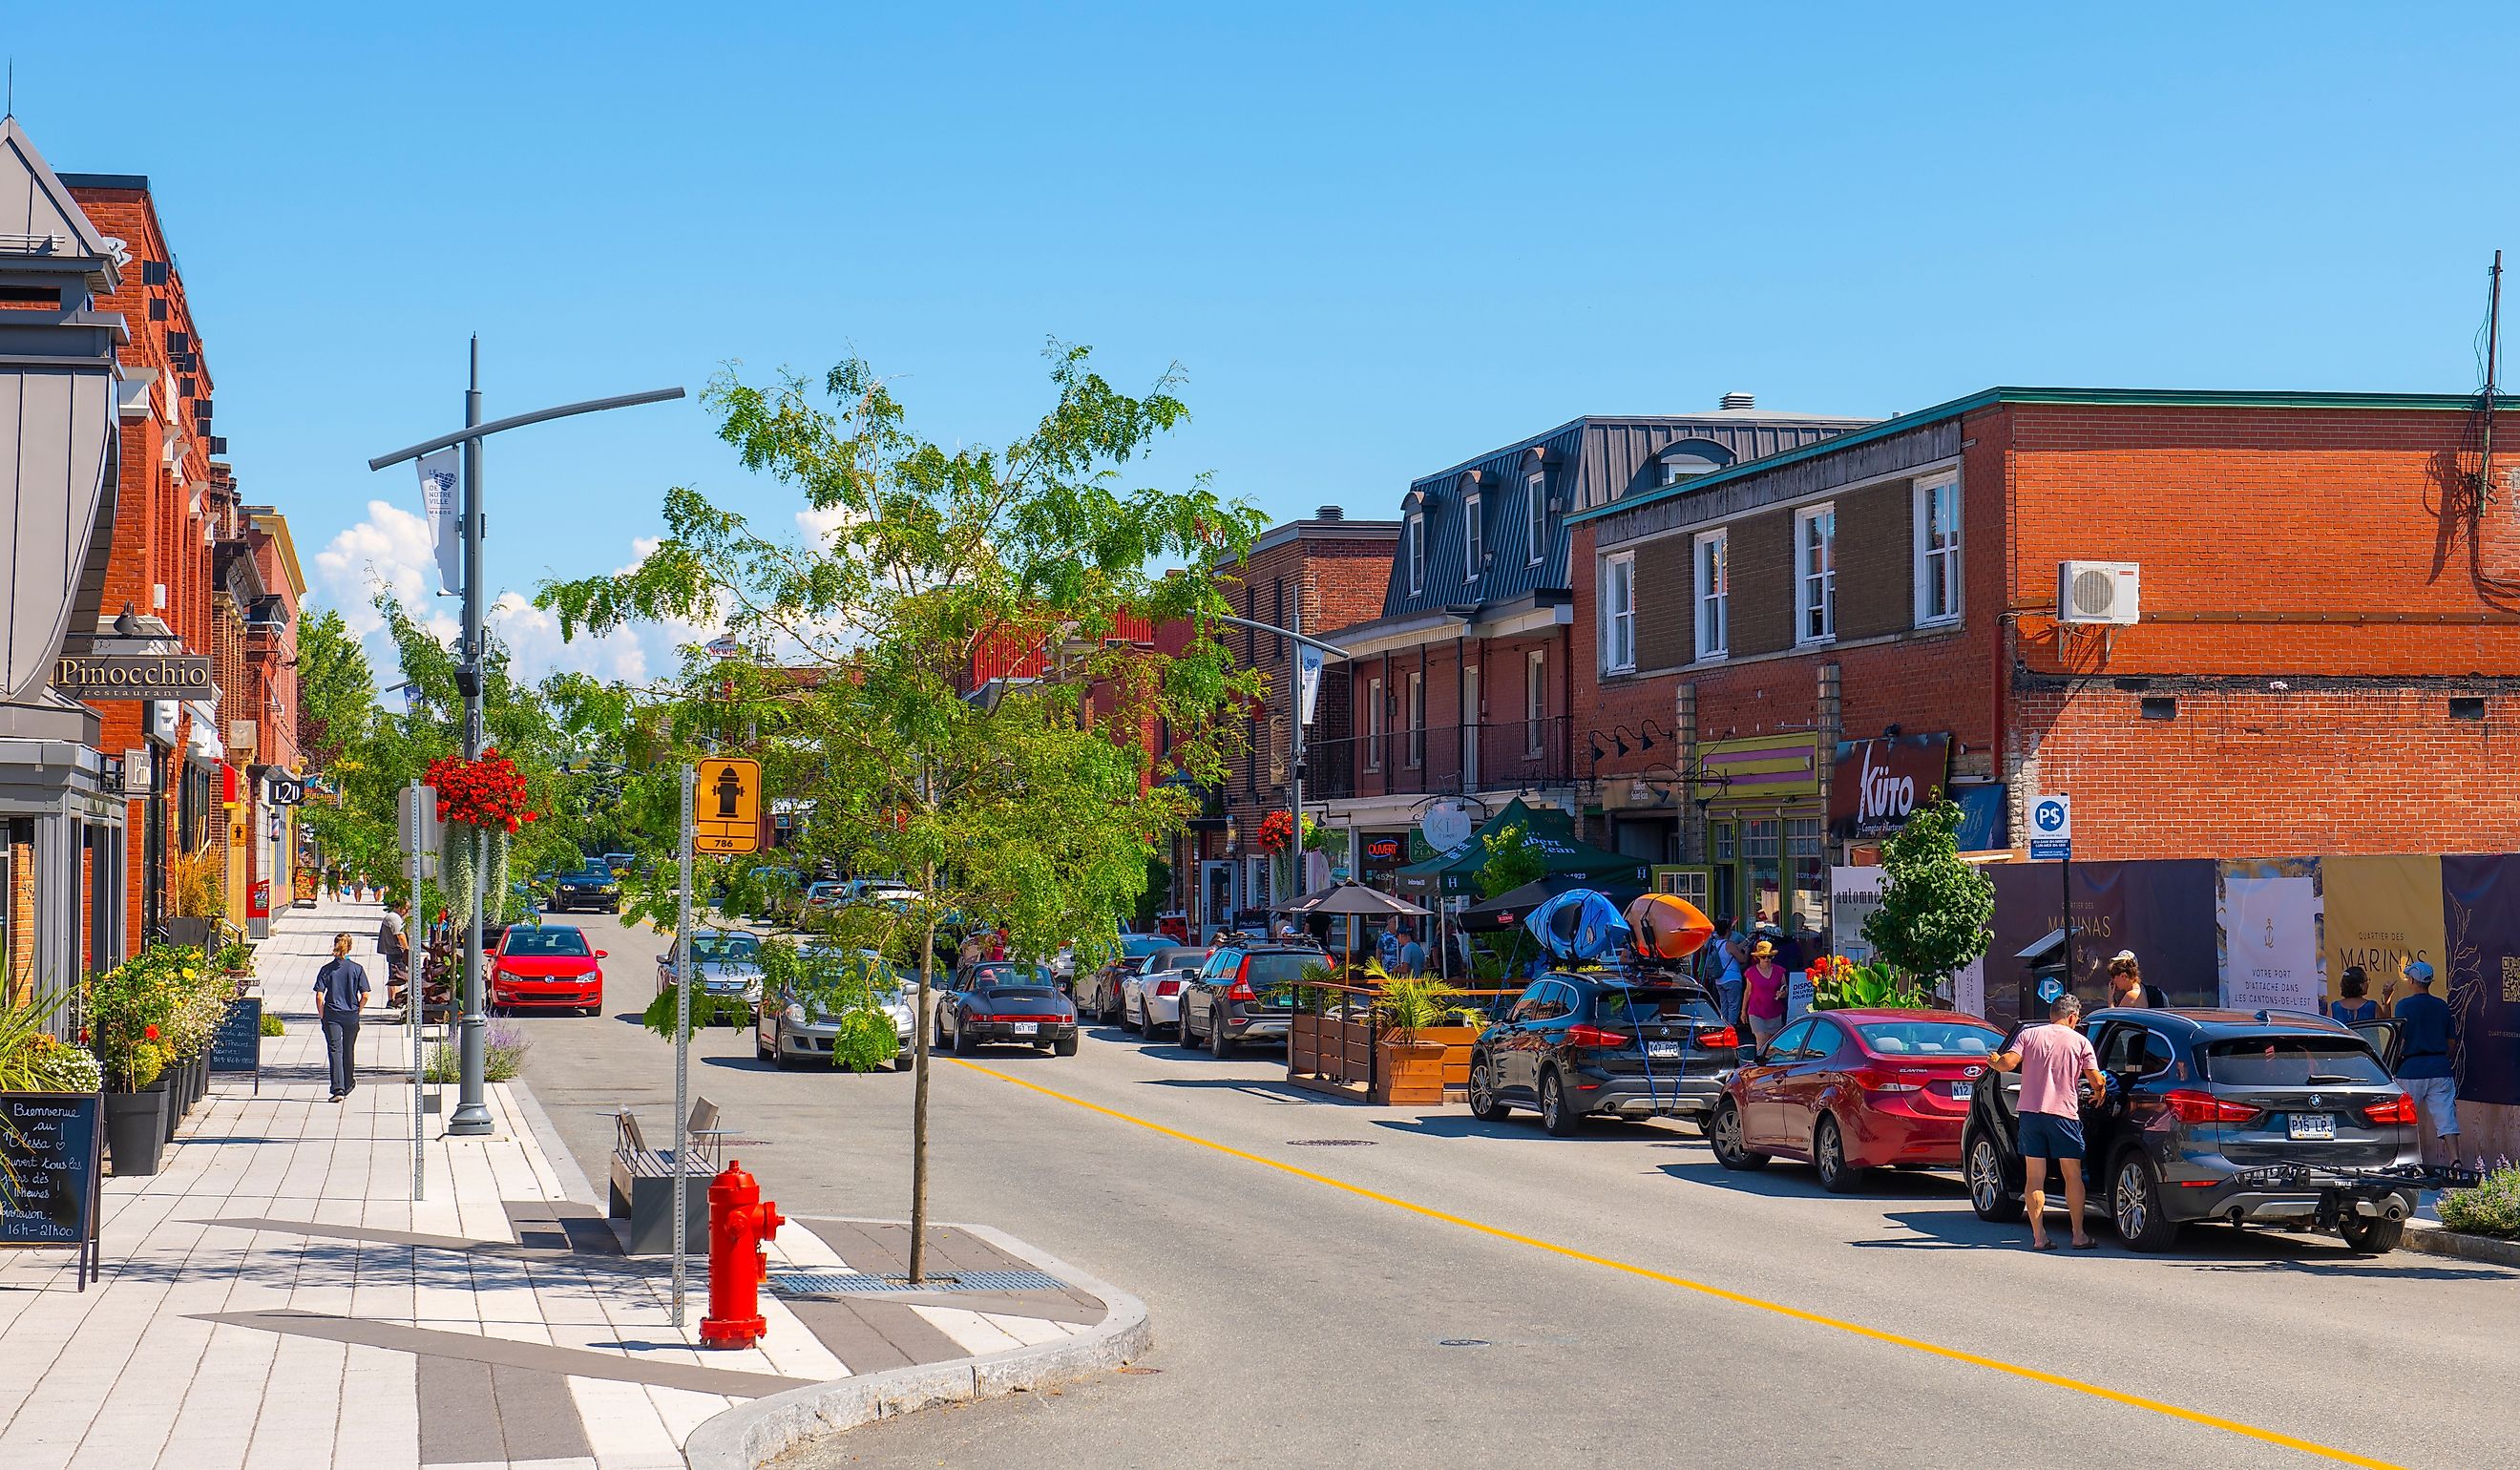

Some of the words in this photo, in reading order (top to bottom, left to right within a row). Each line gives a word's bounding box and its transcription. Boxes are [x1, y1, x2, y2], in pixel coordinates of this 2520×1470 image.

[57, 659, 207, 685] Pinocchio
[274, 782, 301, 804] L2D
[714, 839, 733, 848] 786
[1521, 836, 1562, 848] ubert
[1368, 844, 1396, 855] OUVERT
[1836, 887, 1881, 904] automne
[2391, 933, 2404, 941] DES
[2340, 948, 2427, 973] MARINAS
[2253, 969, 2272, 978] VOTRE
[2275, 970, 2291, 978] PORT
[2245, 981, 2278, 992] D'ATTACHE
[2282, 983, 2300, 993] DANS
[2235, 994, 2246, 1002] LES
[2249, 995, 2311, 1006] CANTONS-DE-L'EST
[1953, 1085, 1969, 1096] N12
[13, 1102, 81, 1118] Bienvenue
[32, 1122, 57, 1132] au
[2292, 1120, 2310, 1132] P15
[2315, 1120, 2333, 1132] LRJ
[3, 1153, 39, 1167] uvert
[41, 1157, 68, 1171] tous
[68, 1156, 83, 1170] les
[32, 1171, 50, 1184] dès
